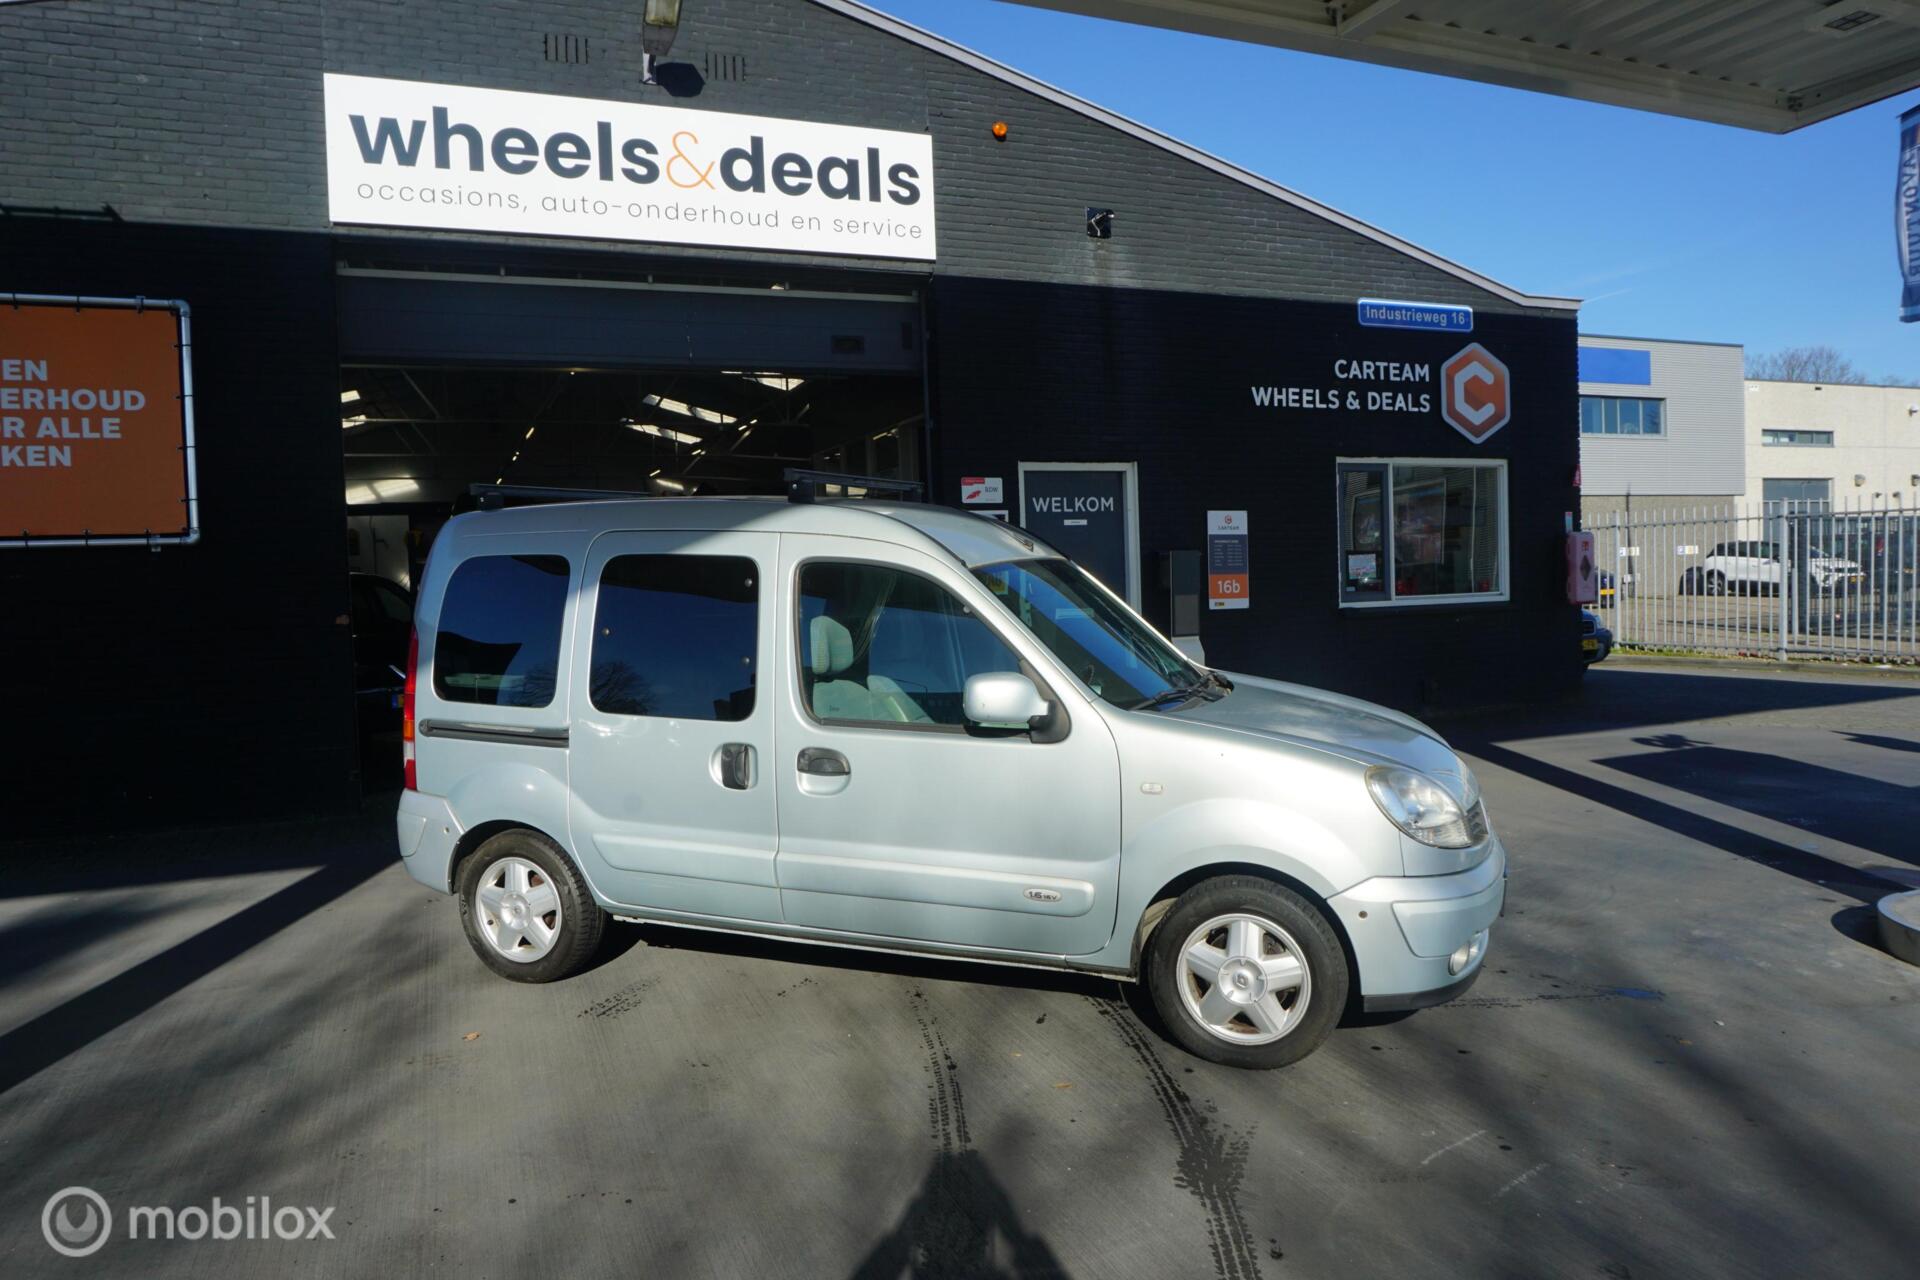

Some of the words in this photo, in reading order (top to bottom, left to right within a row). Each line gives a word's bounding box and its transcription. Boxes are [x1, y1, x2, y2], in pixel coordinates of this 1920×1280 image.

[357, 183, 528, 213] occasions,
[541, 196, 779, 228] auto-onderhoud
[791, 215, 821, 231] en
[833, 218, 923, 239] service
[1366, 305, 1447, 327] Industrieweg
[1451, 311, 1465, 325] 16
[2, 359, 48, 381] EN
[1334, 359, 1430, 382] CARTEAM
[1251, 386, 1340, 409] WHEELS
[1346, 391, 1360, 410] &
[1367, 392, 1431, 413] DEALS
[0, 416, 25, 438] R
[36, 417, 121, 439] ALLE
[1032, 497, 1114, 513] WELKOM
[1217, 580, 1241, 594] 16b
